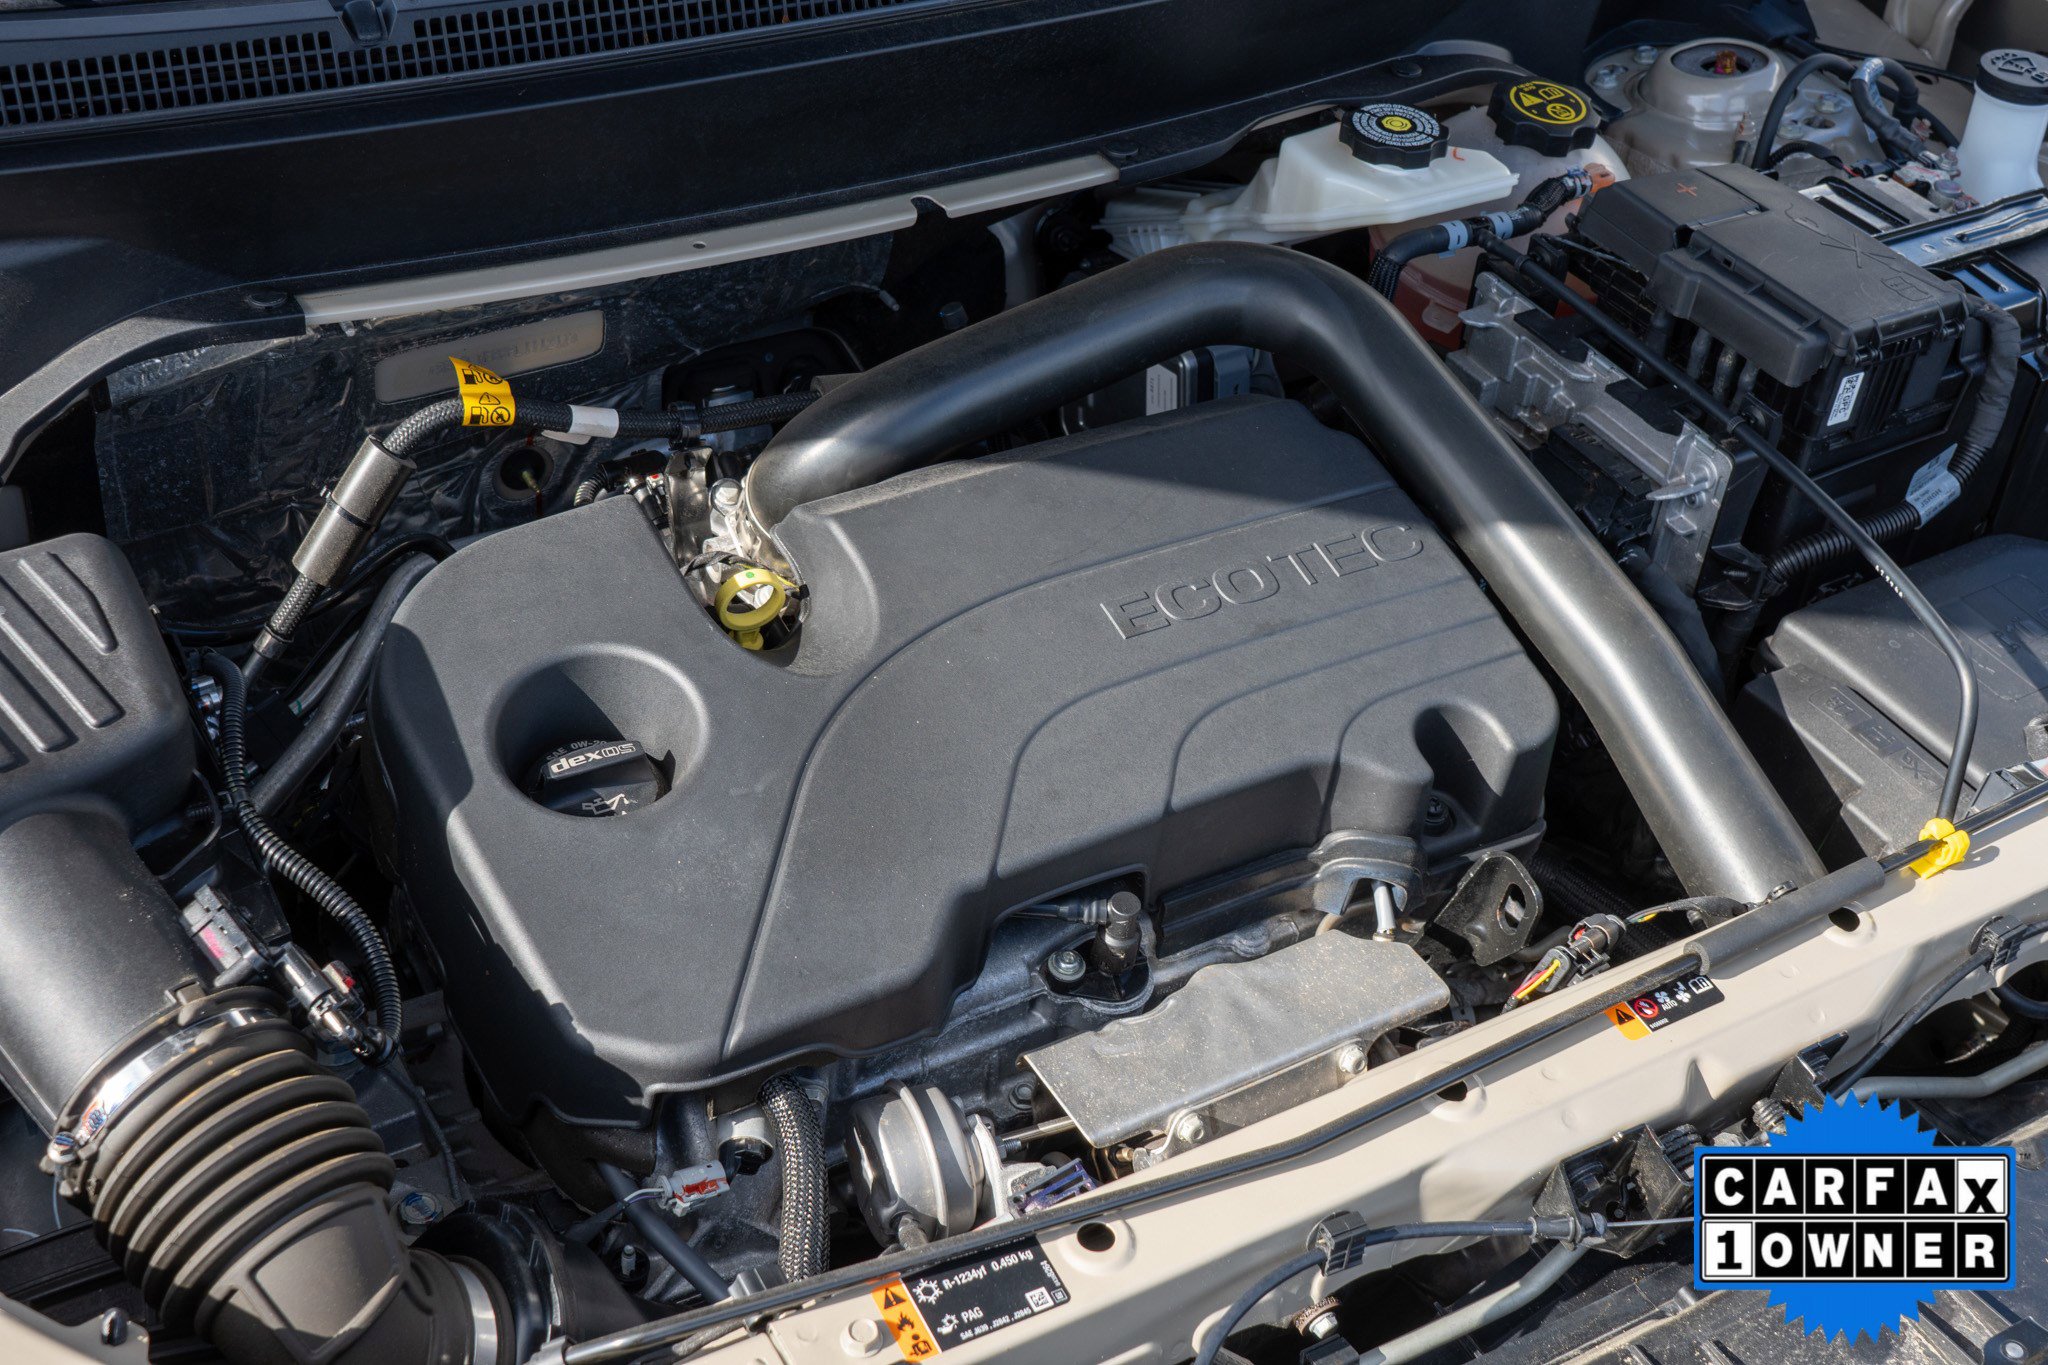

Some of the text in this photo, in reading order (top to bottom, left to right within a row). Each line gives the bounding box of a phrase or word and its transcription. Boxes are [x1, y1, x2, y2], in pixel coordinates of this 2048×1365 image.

[1099, 522, 1425, 640] ECOTEC
[546, 747, 566, 761] SAE
[550, 743, 637, 773] dexos
[1661, 1000, 1678, 1011] AUTO
[941, 1265, 988, 1291] R-1234yf
[990, 1253, 1019, 1272] 0.450
[1019, 1248, 1034, 1263] kg
[960, 1307, 984, 1324] PAG
[960, 1330, 974, 1340] SAE
